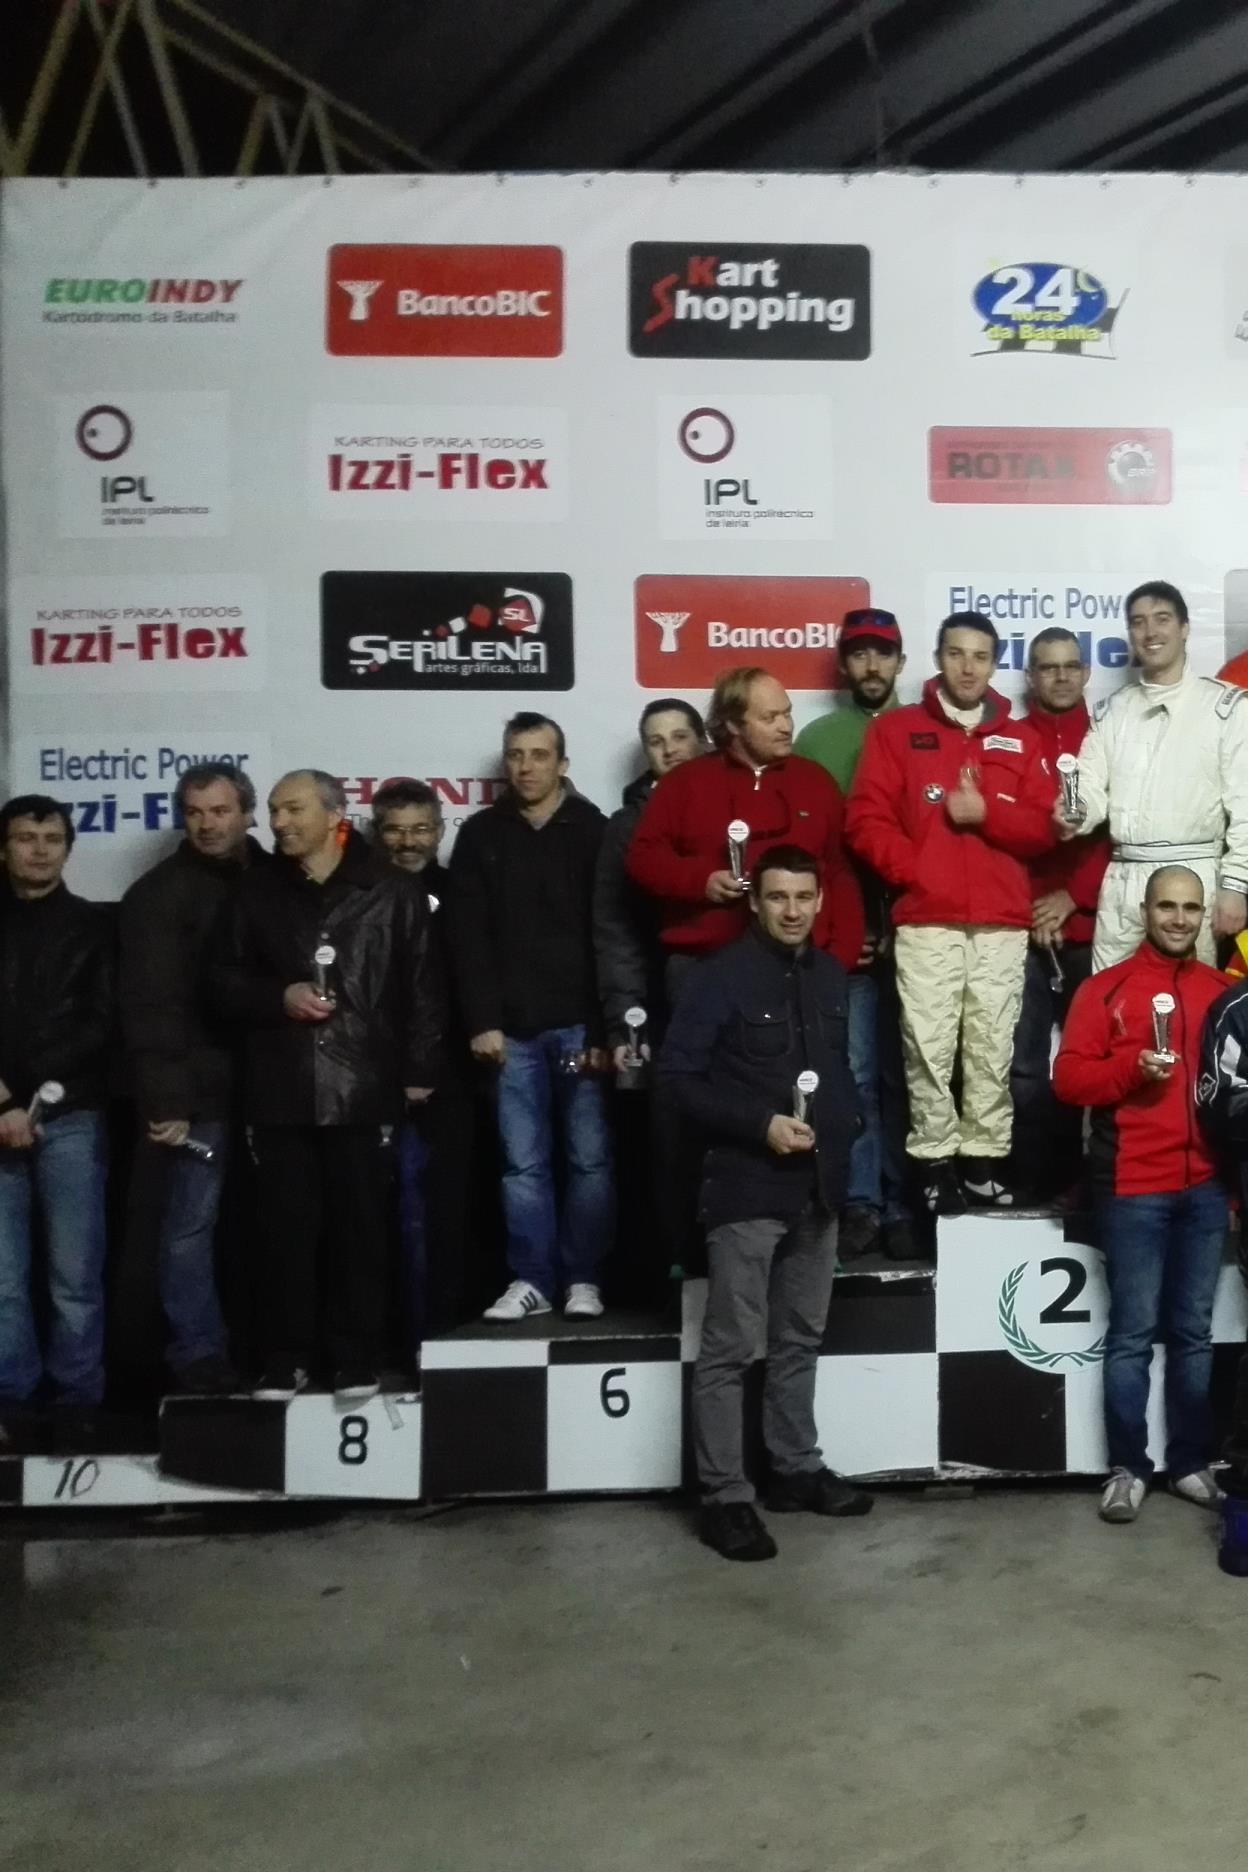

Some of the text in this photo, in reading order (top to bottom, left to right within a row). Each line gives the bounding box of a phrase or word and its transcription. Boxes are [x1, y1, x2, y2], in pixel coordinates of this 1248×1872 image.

[688, 255, 779, 288] Kart
[45, 279, 243, 303] EUROINDY
[397, 290, 551, 317] BancoBIC
[643, 274, 855, 333] Shopping
[991, 267, 1081, 316] 24
[986, 323, 1101, 341] da Batalha
[334, 437, 545, 450] KARTING PARA TODOS
[328, 453, 549, 491] Izzi-Flex
[101, 476, 155, 503] IPL
[703, 479, 759, 505] IPL
[36, 606, 243, 620] KARTING PARA TODOS
[950, 586, 1123, 619] Electric Pow
[30, 624, 248, 666] Izzi-Flex
[424, 662, 457, 673] artes
[40, 748, 147, 782] Electric
[1039, 1255, 1092, 1324] 2
[599, 1368, 630, 1418] 6
[338, 1415, 368, 1464] 8
[53, 1458, 101, 1499] 10
